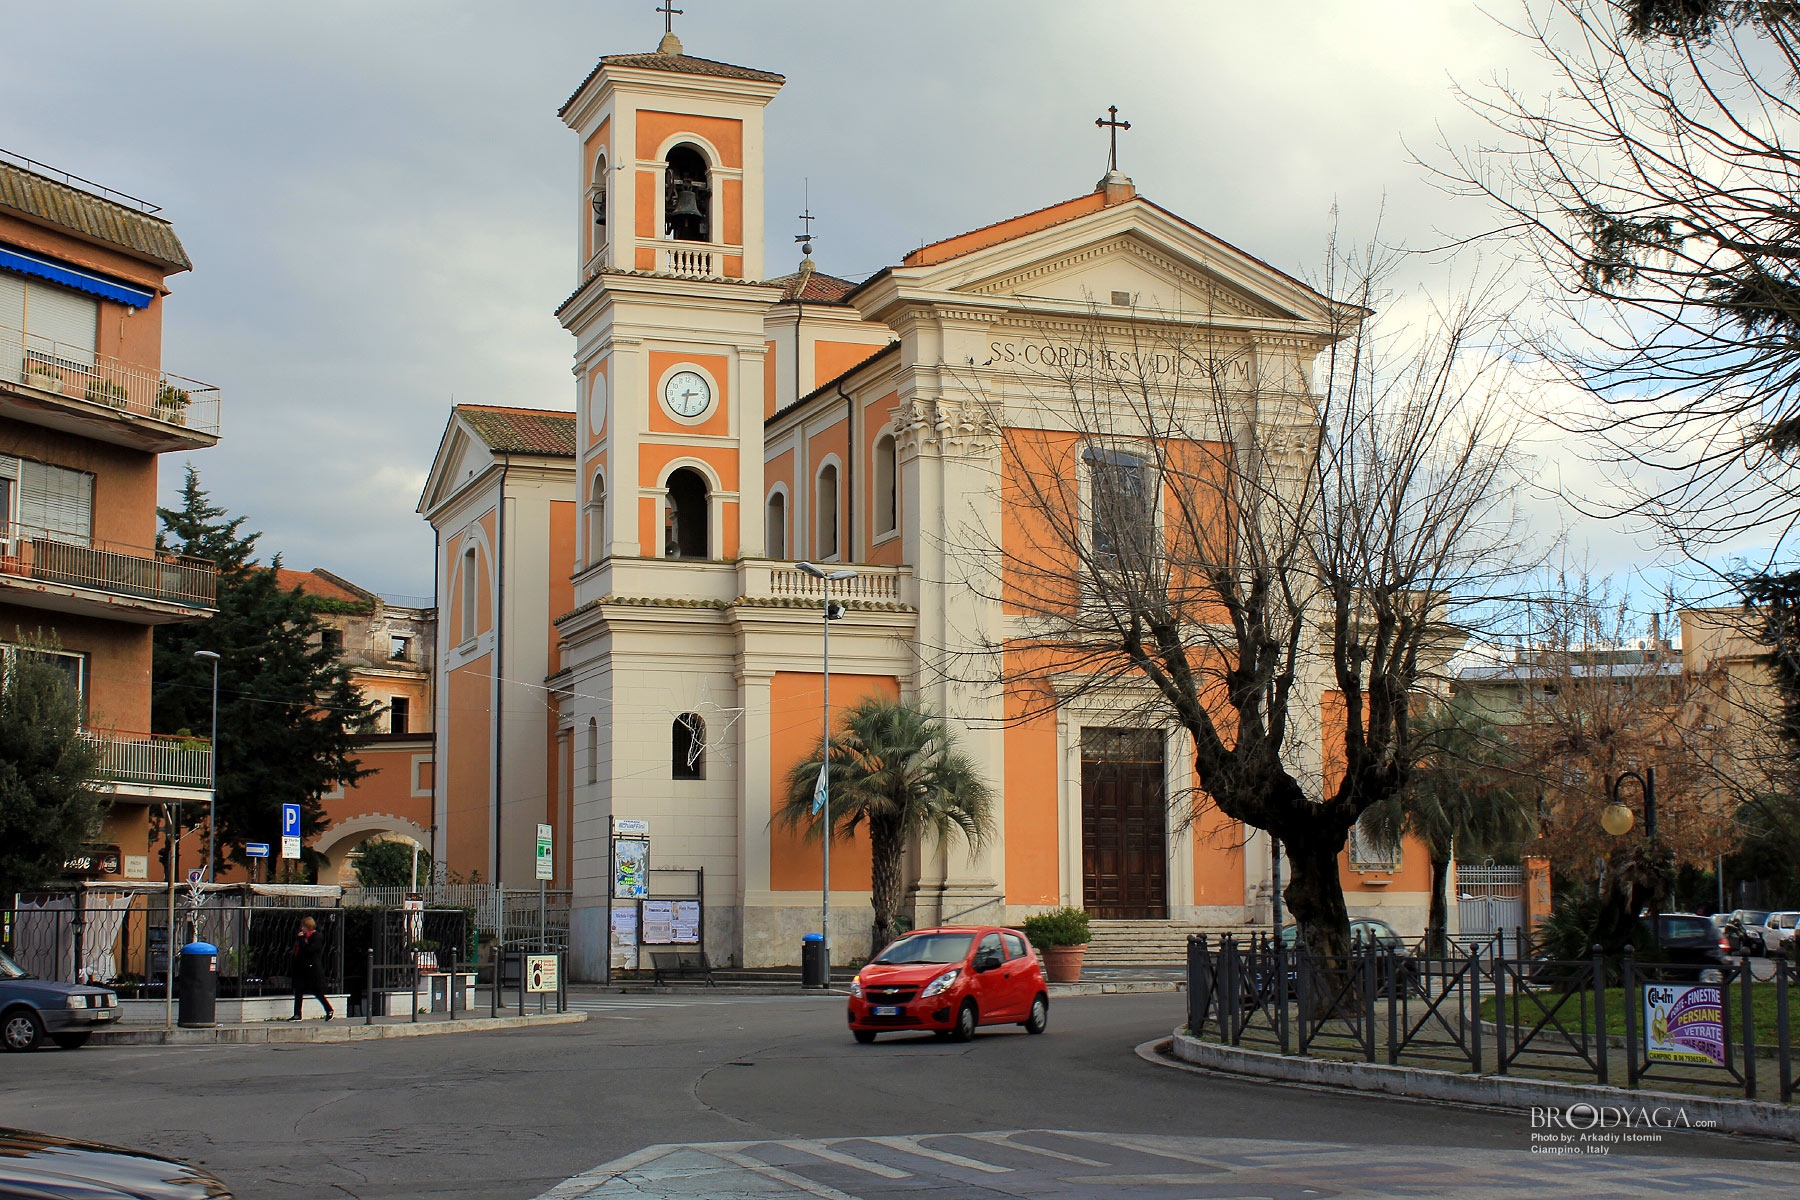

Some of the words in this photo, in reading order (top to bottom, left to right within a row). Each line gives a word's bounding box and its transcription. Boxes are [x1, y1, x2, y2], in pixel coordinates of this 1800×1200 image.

[286, 808, 297, 832] P
[1678, 1008, 1721, 1026] PERSIANE
[1684, 1026, 1722, 1041] VETRATE
[1649, 1052, 1672, 1060] CIAMPINO
